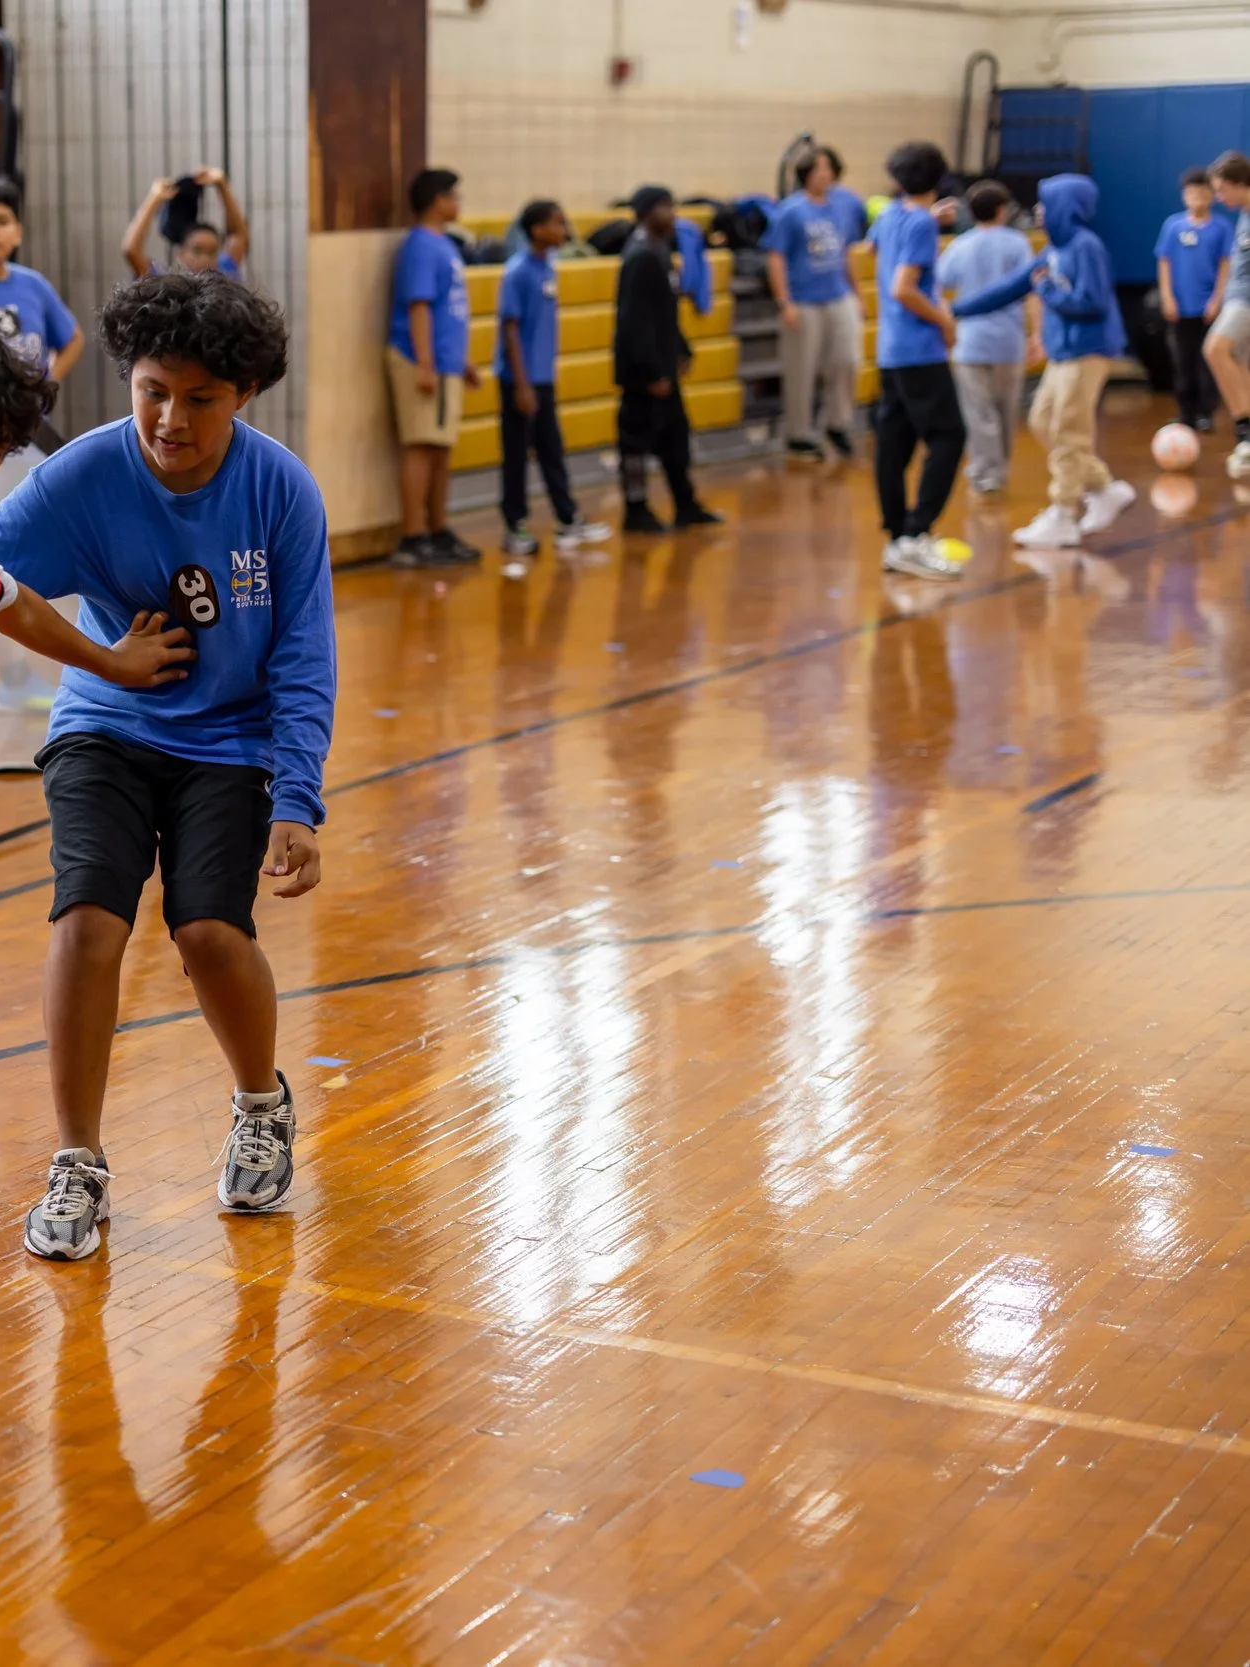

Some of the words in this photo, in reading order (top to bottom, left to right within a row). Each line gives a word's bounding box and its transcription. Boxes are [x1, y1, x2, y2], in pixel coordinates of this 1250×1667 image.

[230, 550, 267, 571] MS
[253, 571, 267, 593] 5
[177, 569, 216, 623] 30
[254, 594, 266, 602] OF
